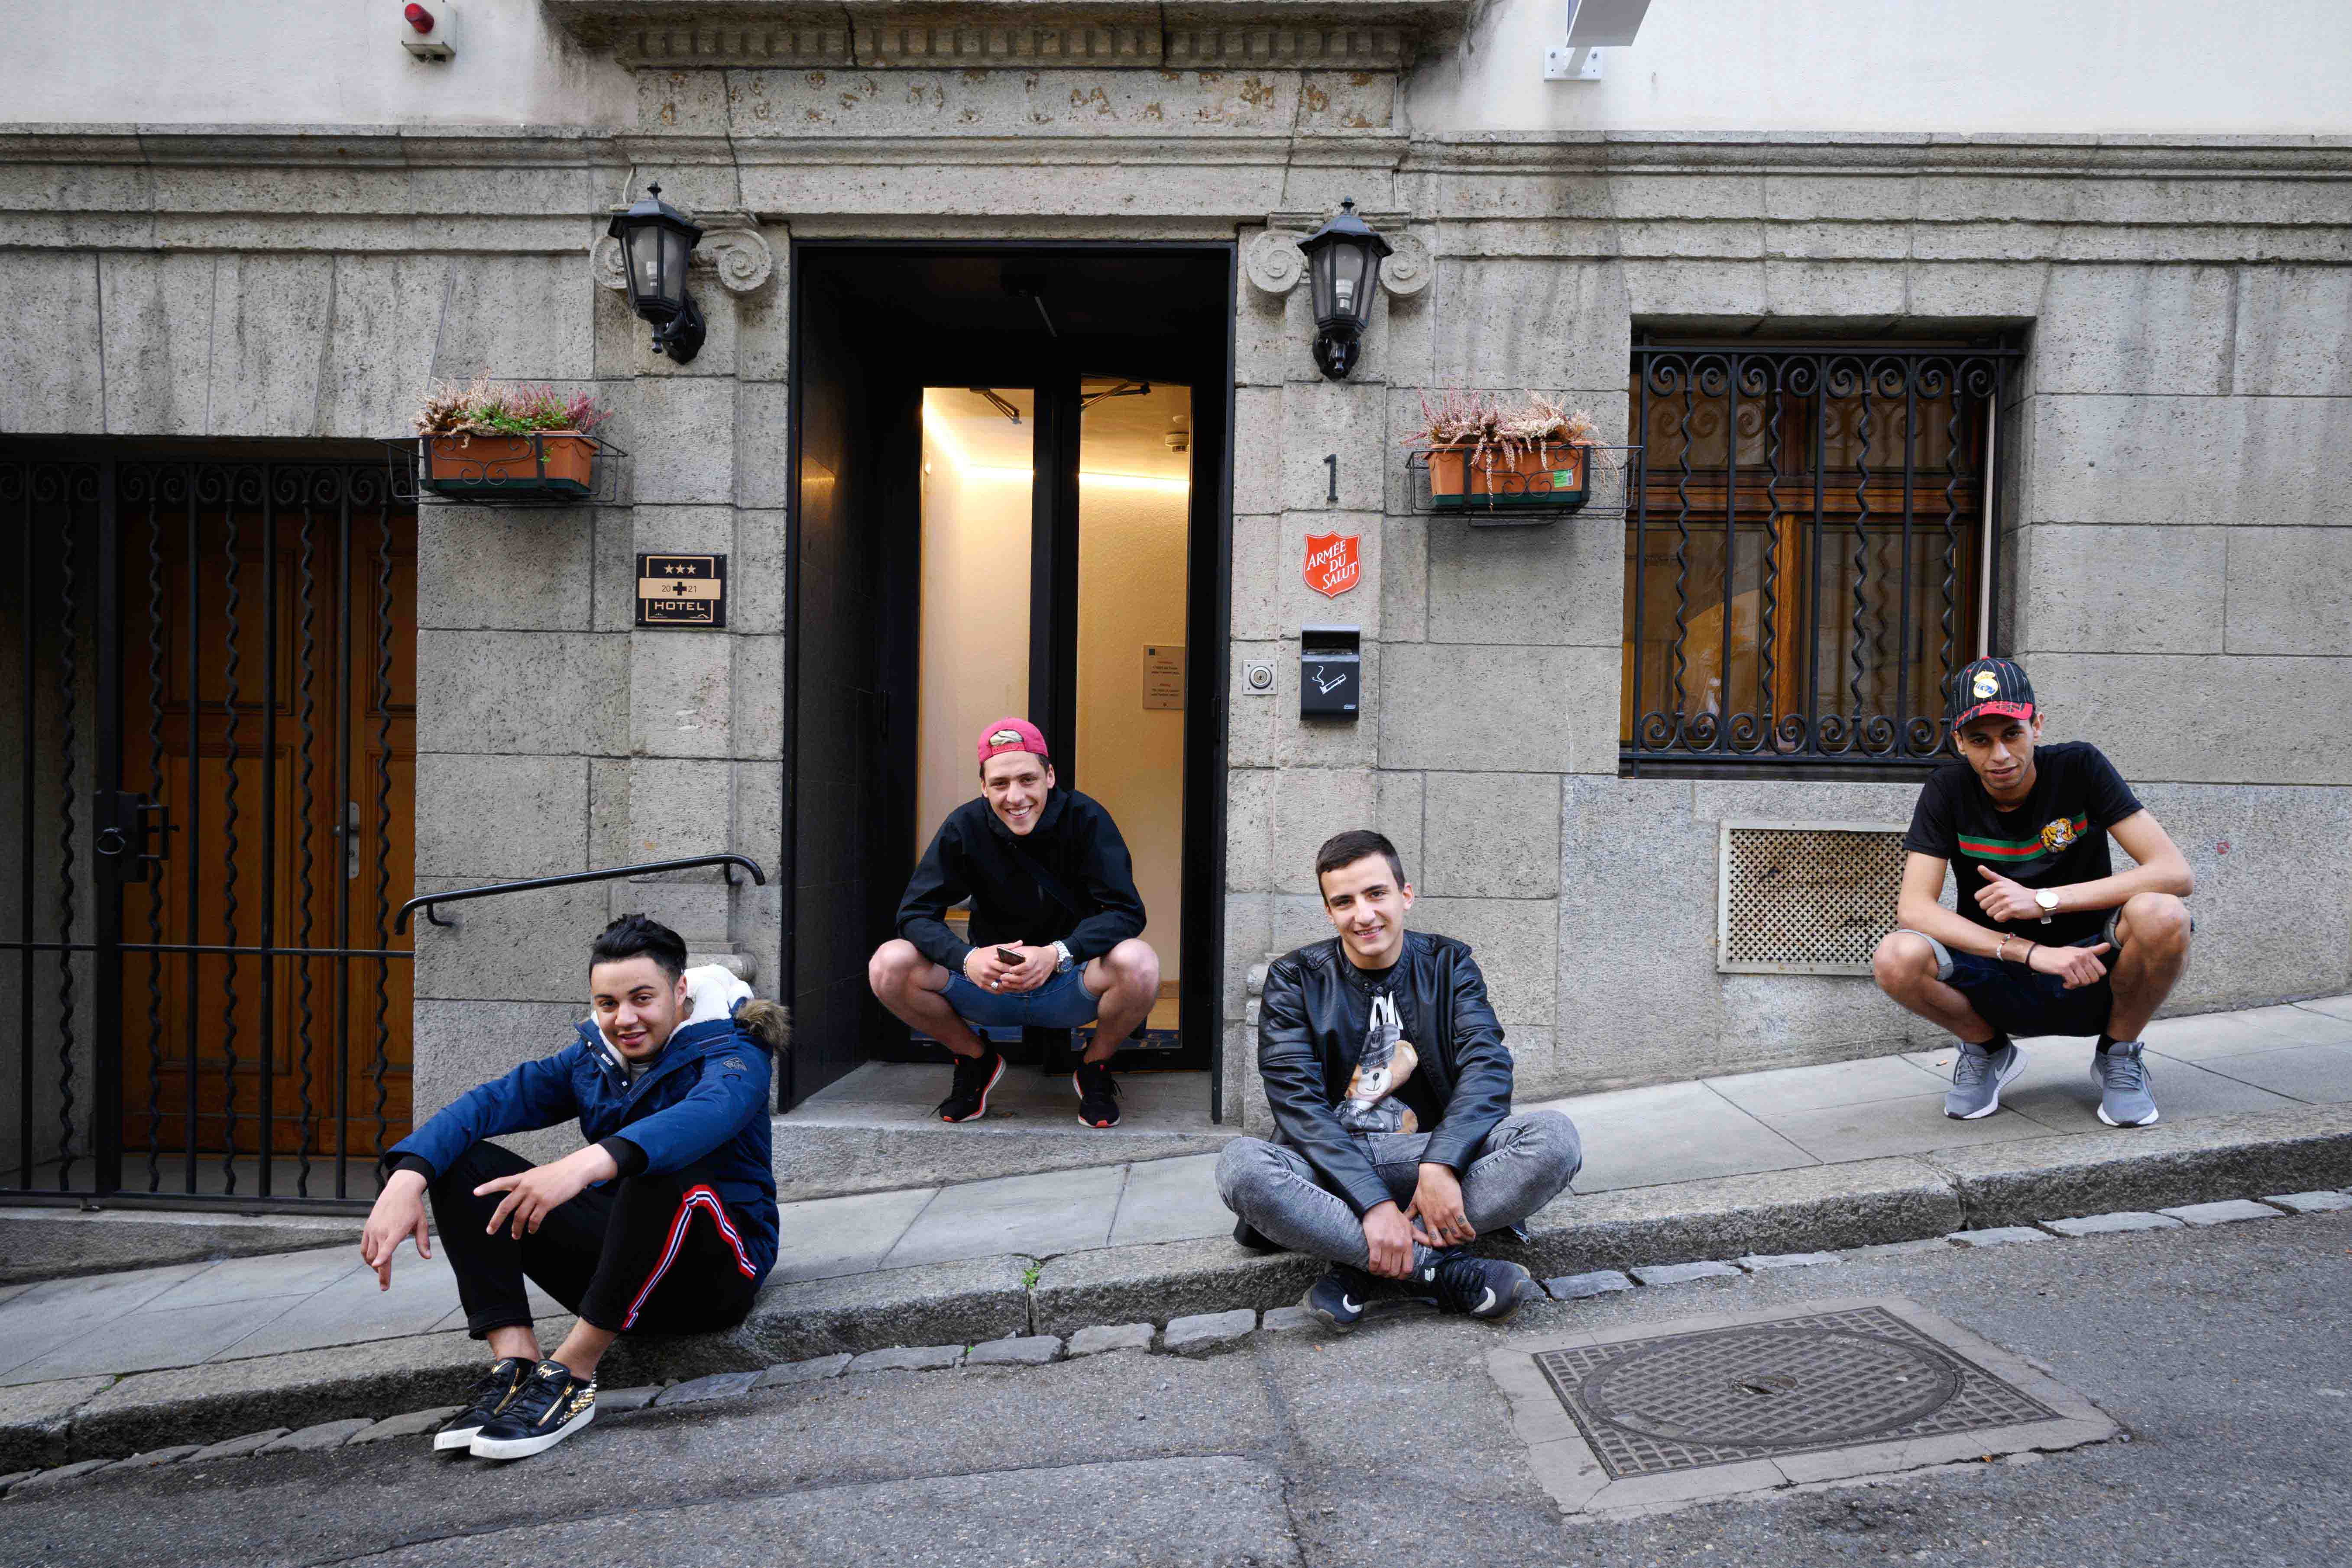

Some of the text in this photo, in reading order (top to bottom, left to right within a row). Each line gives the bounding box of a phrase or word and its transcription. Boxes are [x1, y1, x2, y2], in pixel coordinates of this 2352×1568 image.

[1322, 454, 1338, 501] 1
[1306, 539, 1346, 572] ARMÉE
[1329, 553, 1347, 573] DU
[1322, 560, 1357, 590] SALUT
[654, 601, 705, 611] HOTEL
